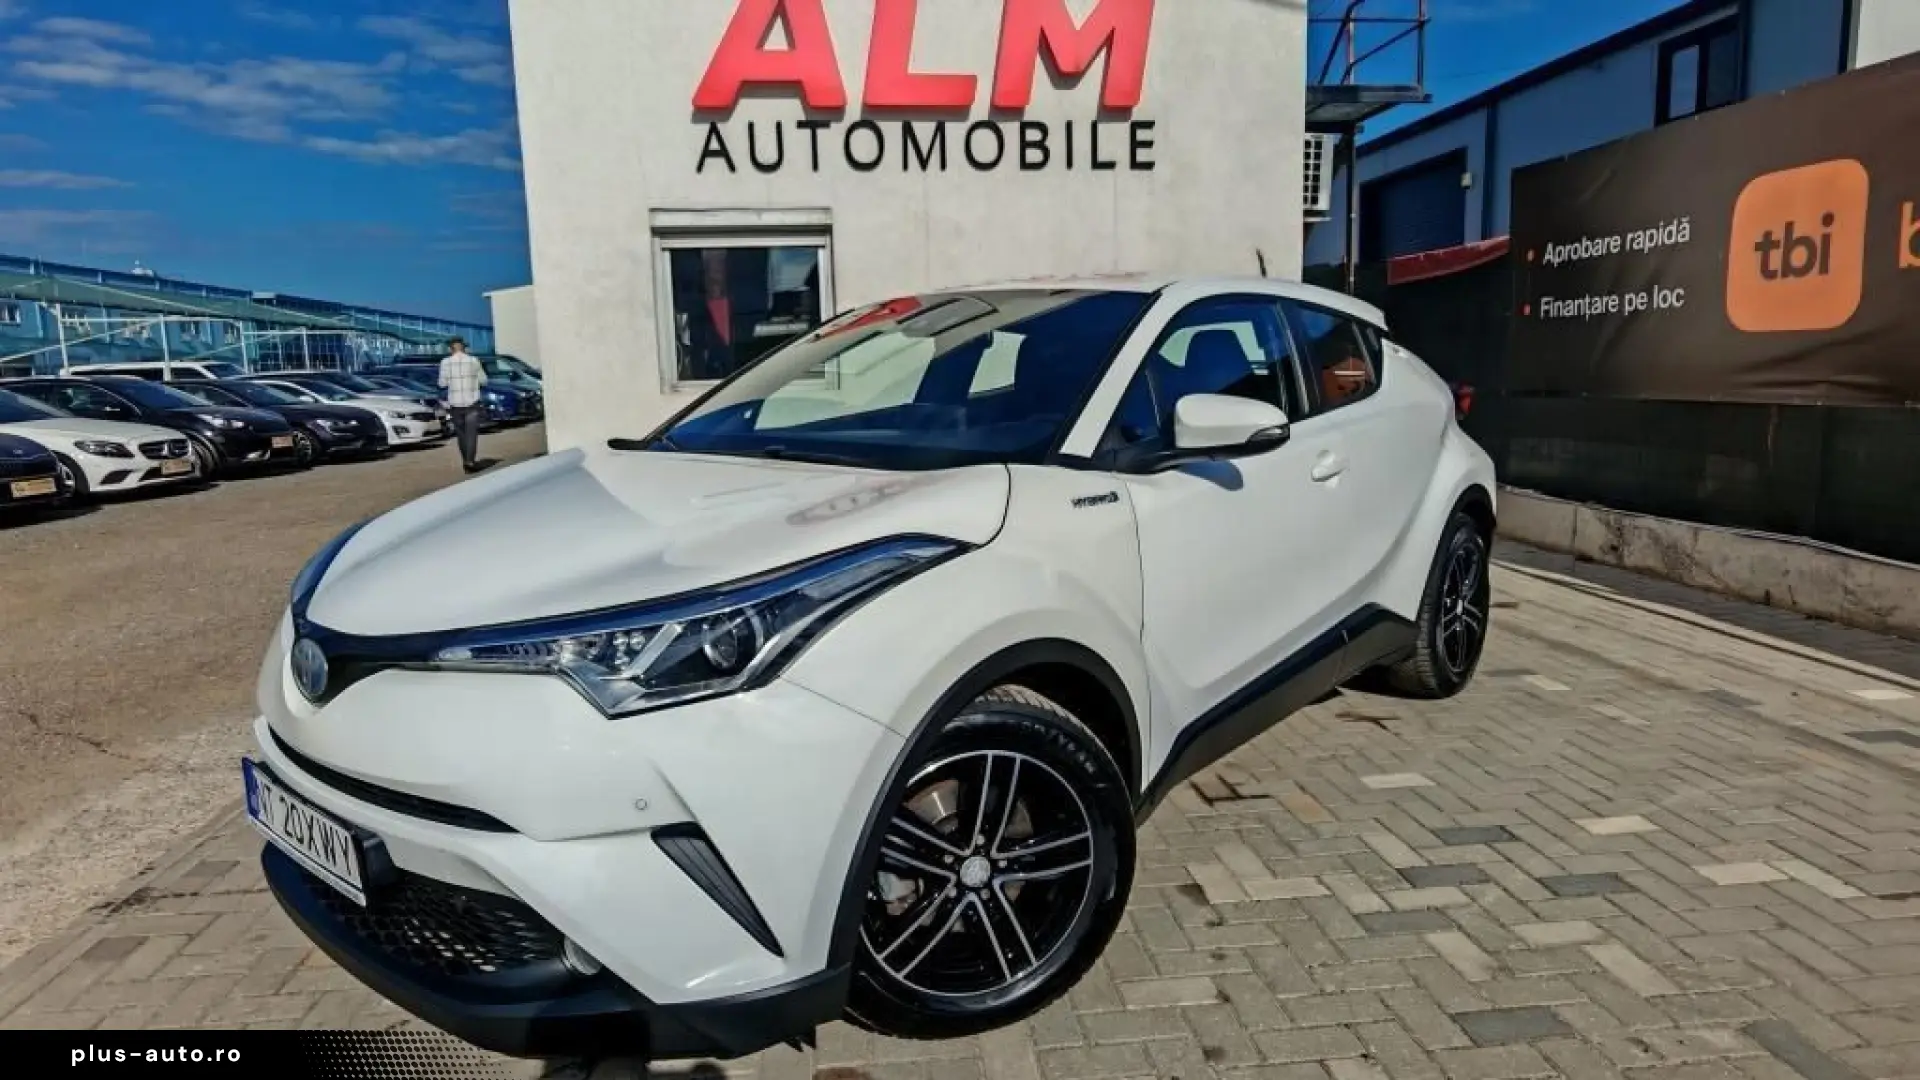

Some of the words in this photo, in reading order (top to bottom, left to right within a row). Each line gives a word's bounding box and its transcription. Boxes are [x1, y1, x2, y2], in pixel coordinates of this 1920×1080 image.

[692, 0, 1155, 109] ALM
[696, 119, 1155, 173] AUTOMOBILE
[1543, 233, 1621, 267] Aprobare
[1626, 216, 1690, 253] rapidă
[1754, 212, 1835, 281] tbi
[1624, 291, 1649, 315] pe
[1653, 284, 1685, 309] loc
